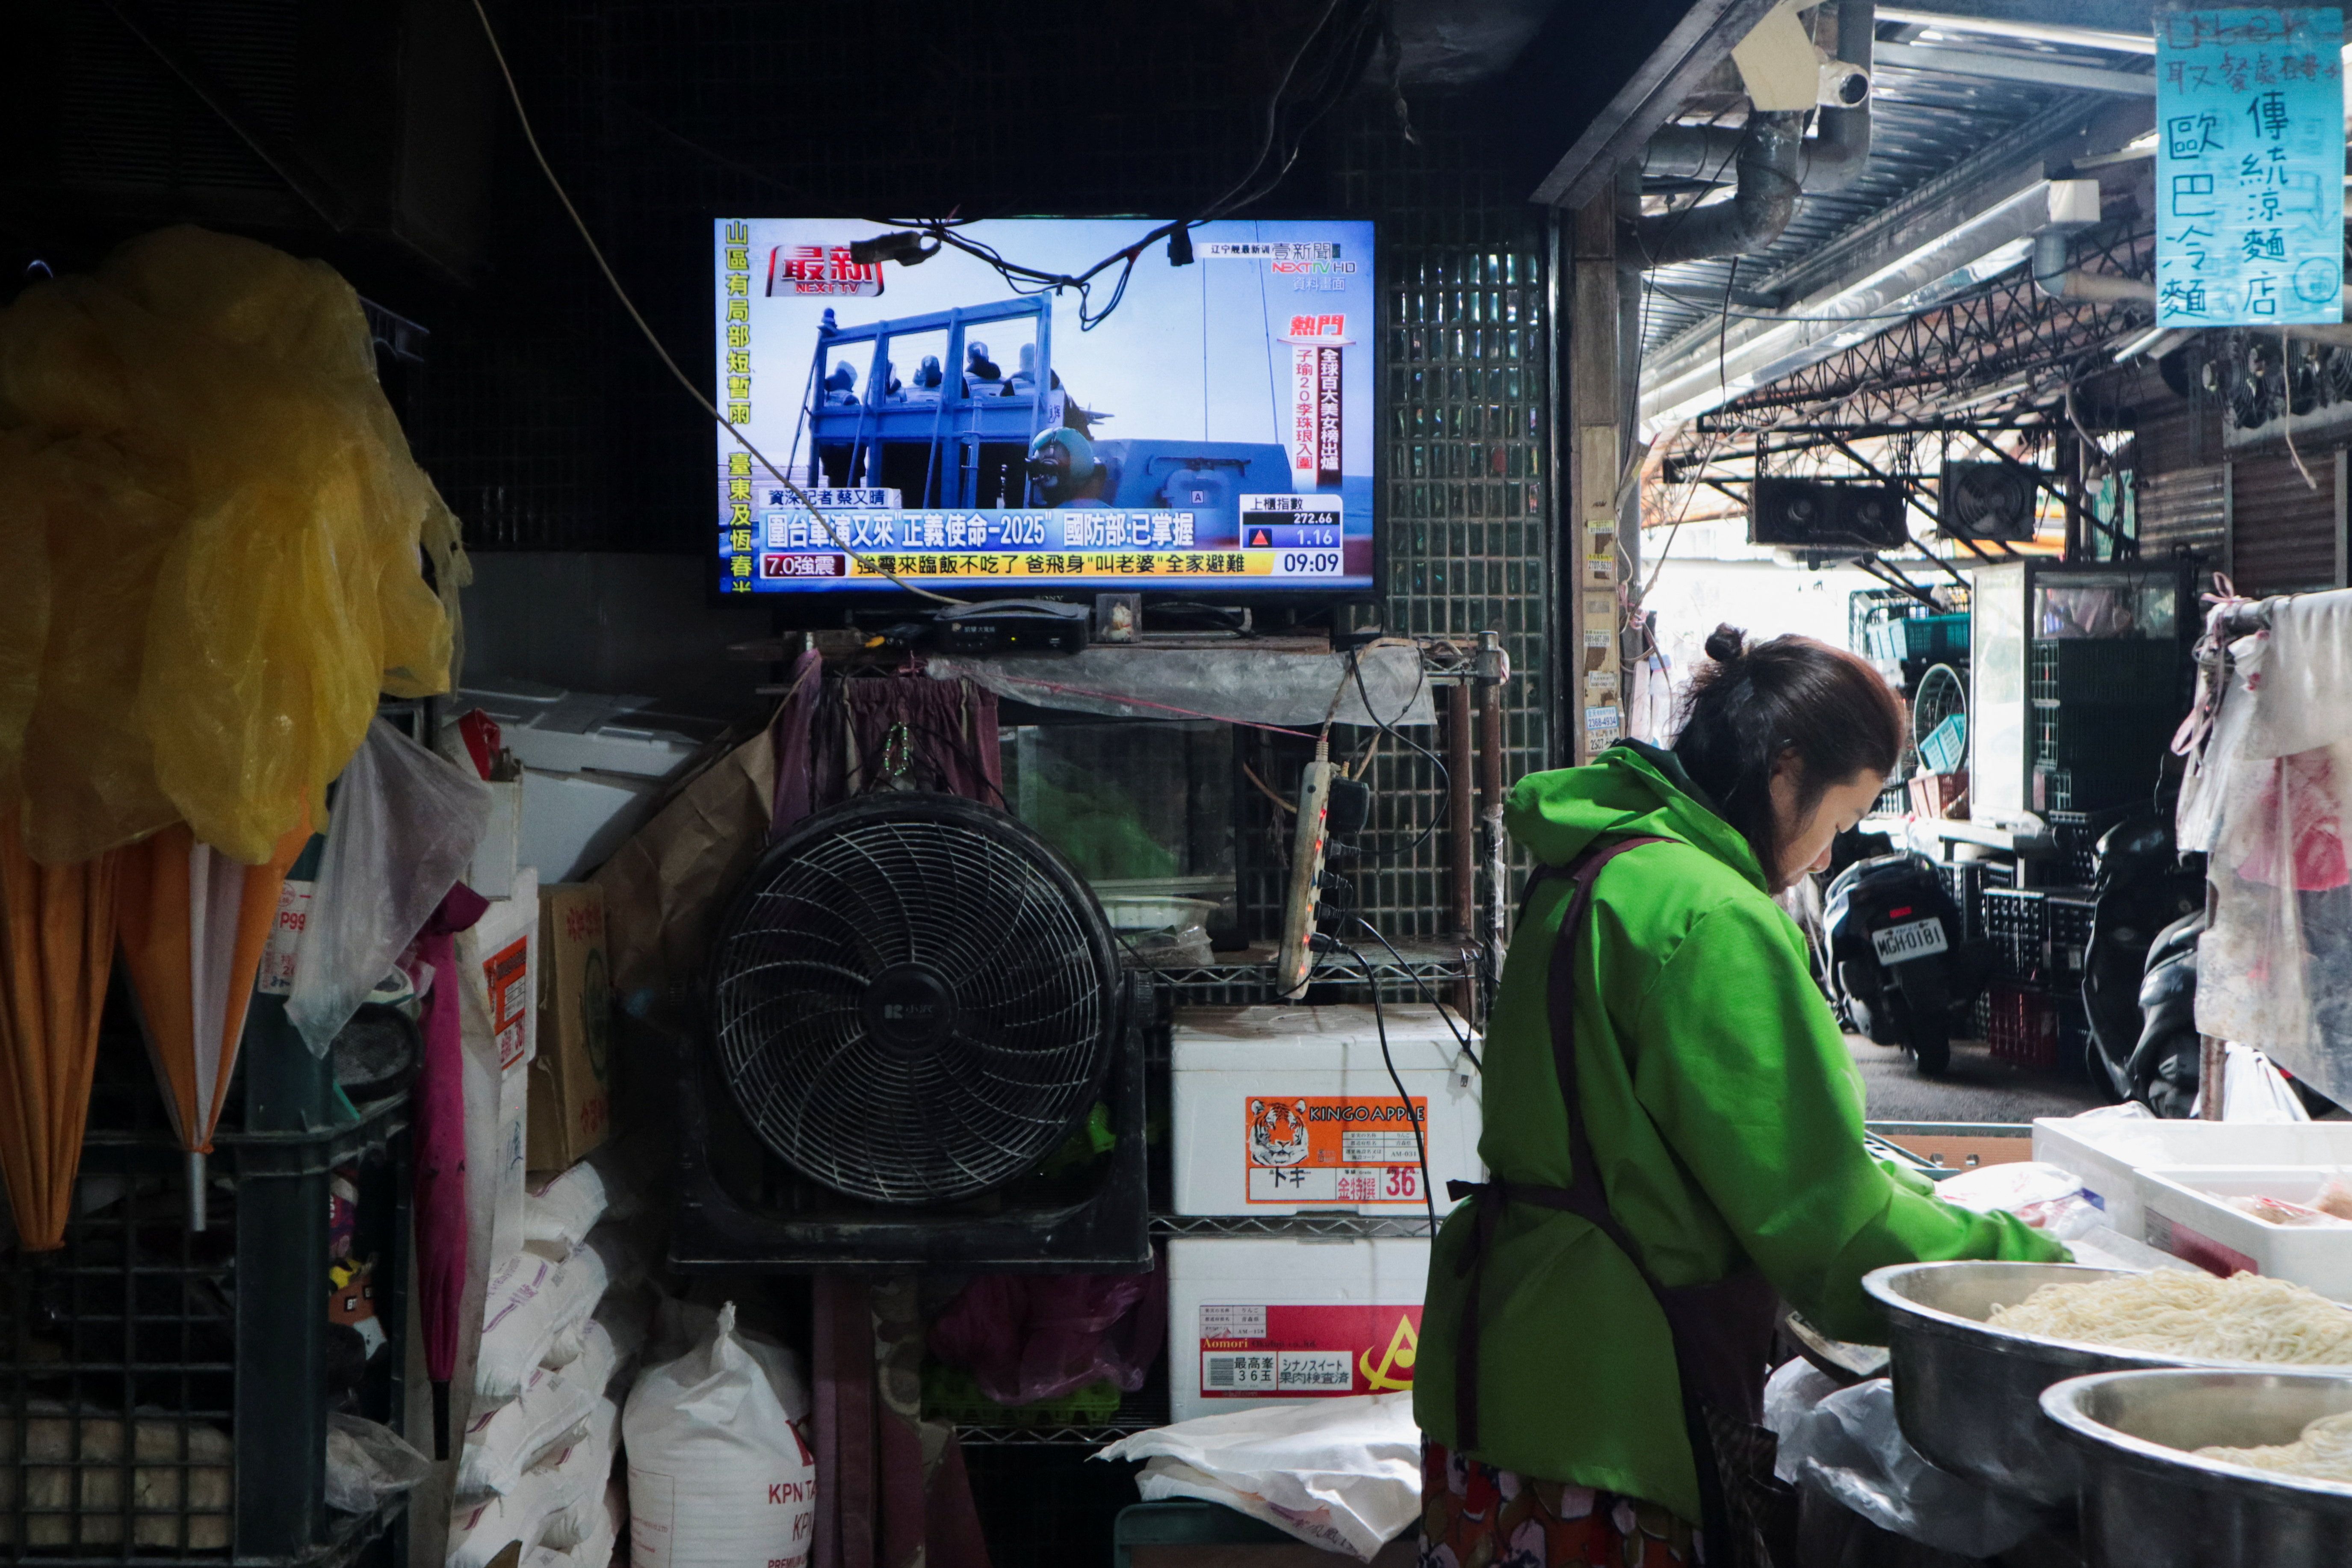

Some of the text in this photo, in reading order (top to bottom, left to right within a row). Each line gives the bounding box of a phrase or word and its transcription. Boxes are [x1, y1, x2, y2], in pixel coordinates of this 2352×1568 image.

[2240, 91, 2289, 315] 傳統涼麵店
[2161, 113, 2224, 319] 歐巴冷麵
[1272, 242, 1332, 260] 壹新聞
[782, 245, 872, 281] 最新
[796, 283, 859, 293] NEXT TV
[1293, 276, 1345, 291] 資料畫面
[725, 221, 751, 425] 山區有局部短暫雨
[1289, 314, 1346, 336] 熱門
[1321, 349, 1339, 470] 全球百大美女榜出爐
[768, 490, 885, 505] 資深記者 蔡又晴
[1250, 497, 1303, 511] 上櫃指數
[1294, 513, 1333, 524] 272.66
[1297, 529, 1333, 545] 1.16
[767, 556, 835, 575] 7.0強震
[1284, 553, 1339, 572] 09:09
[1386, 1166, 1415, 1196] 36
[1203, 1338, 1248, 1348] Aomori
[1282, 1359, 1342, 1371] シナノスイート
[1279, 1372, 1349, 1384] 果肉検査済
[768, 1482, 803, 1504] KPN
